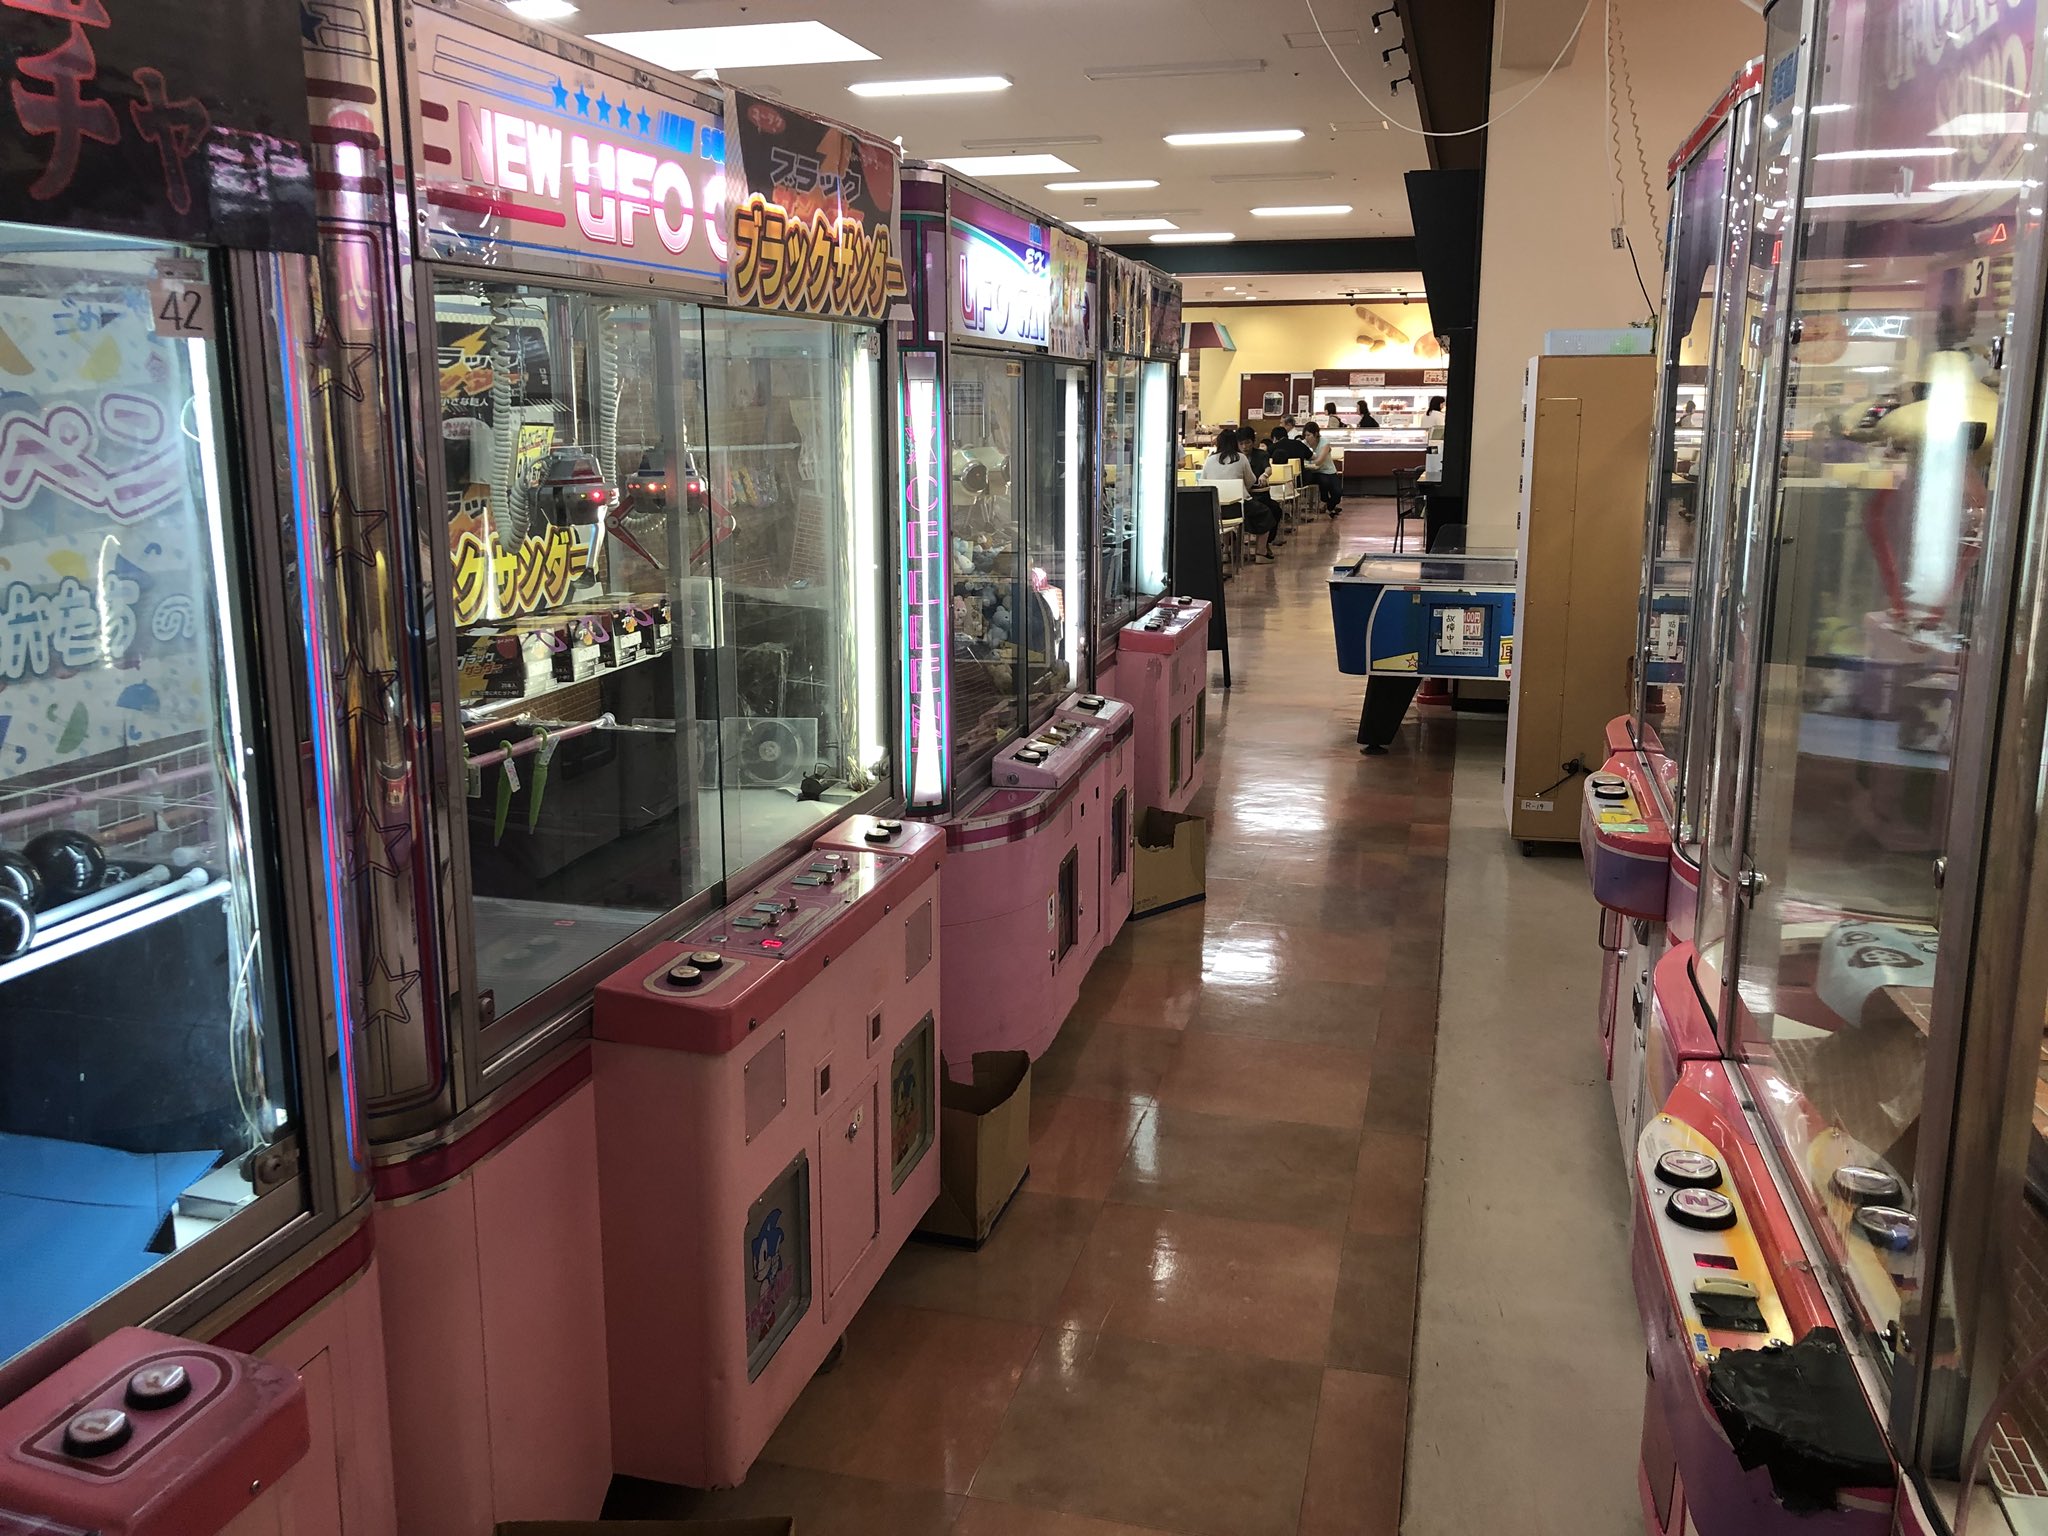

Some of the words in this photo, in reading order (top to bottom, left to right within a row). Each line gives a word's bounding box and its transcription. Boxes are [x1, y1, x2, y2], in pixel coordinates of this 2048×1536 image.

[458, 100, 562, 199] NEW
[571, 134, 695, 254] UFO
[160, 291, 203, 331] 42
[734, 193, 907, 318] ブラックサンダー
